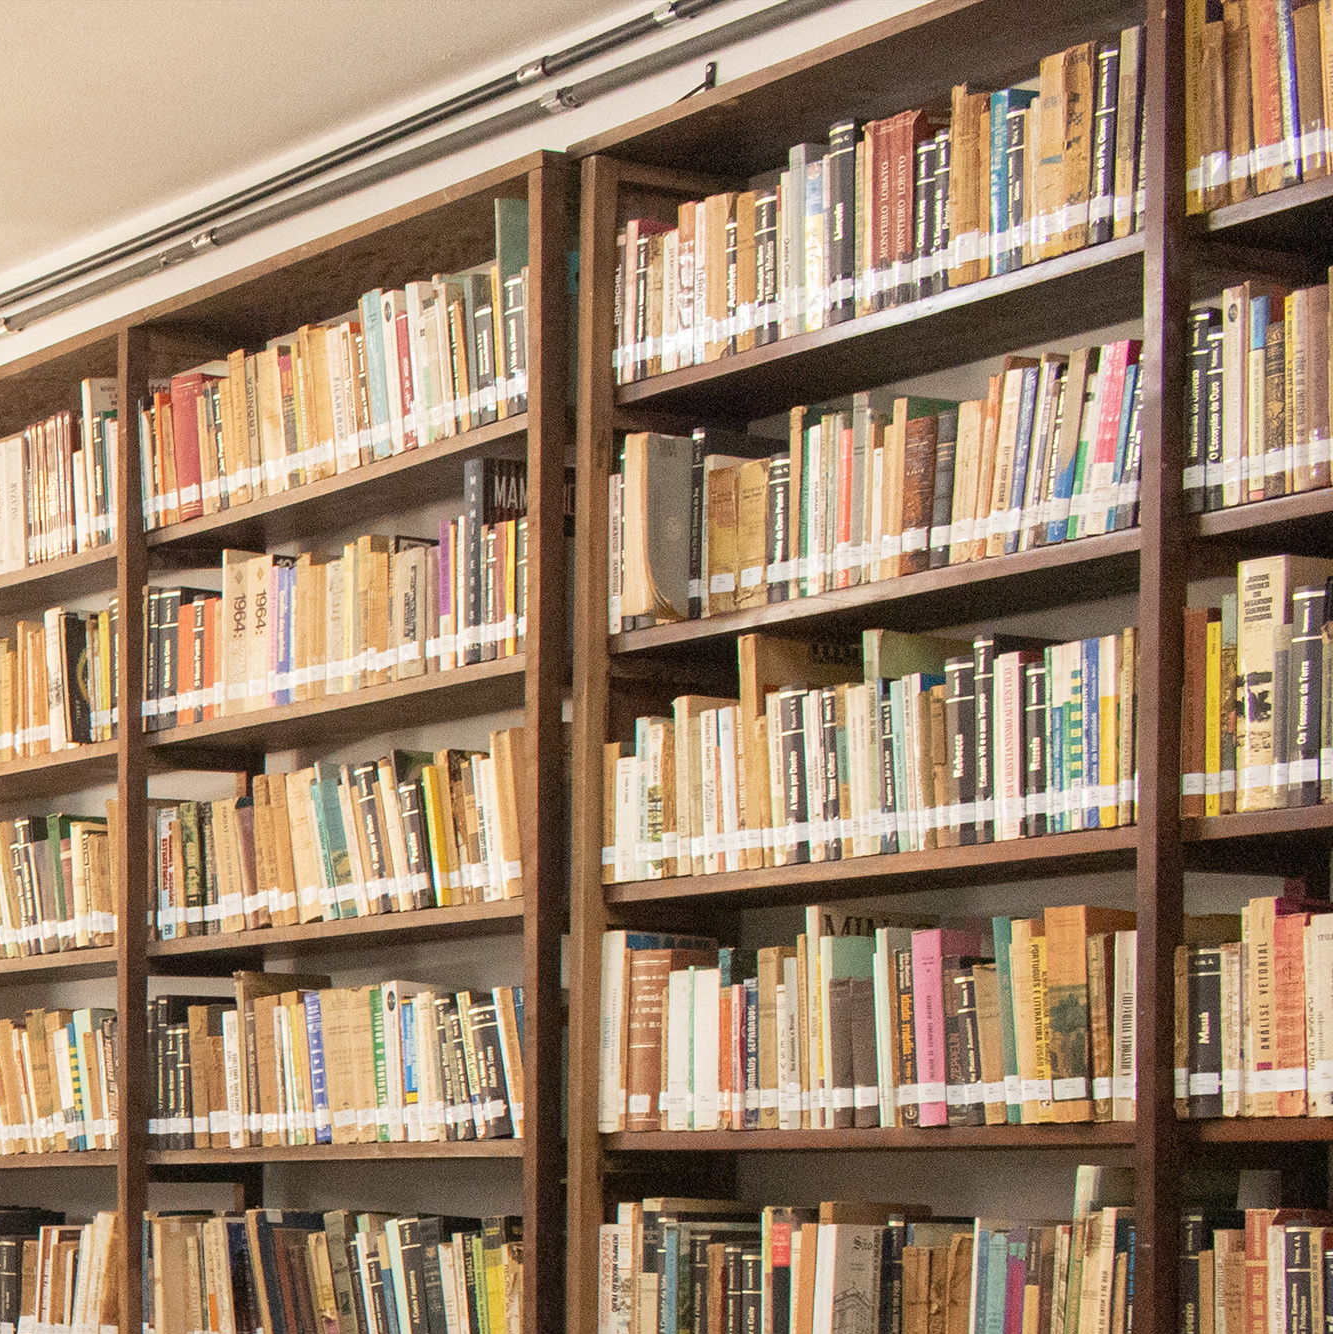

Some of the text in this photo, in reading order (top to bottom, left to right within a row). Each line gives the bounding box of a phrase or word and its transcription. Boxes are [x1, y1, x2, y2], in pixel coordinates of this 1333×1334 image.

[834, 202, 844, 241] Lincoln
[880, 161, 889, 258] MONTEIRO LOBATO
[896, 156, 906, 252] MONTEIRO LOBATO
[333, 376, 344, 440] FILANTROP
[233, 593, 246, 639] 1964:
[255, 589, 268, 634] 1964:
[1298, 661, 1310, 682] Terra
[953, 734, 963, 778] Rebecca
[1257, 941, 1270, 1050] ANÁLISE VETORIAL
